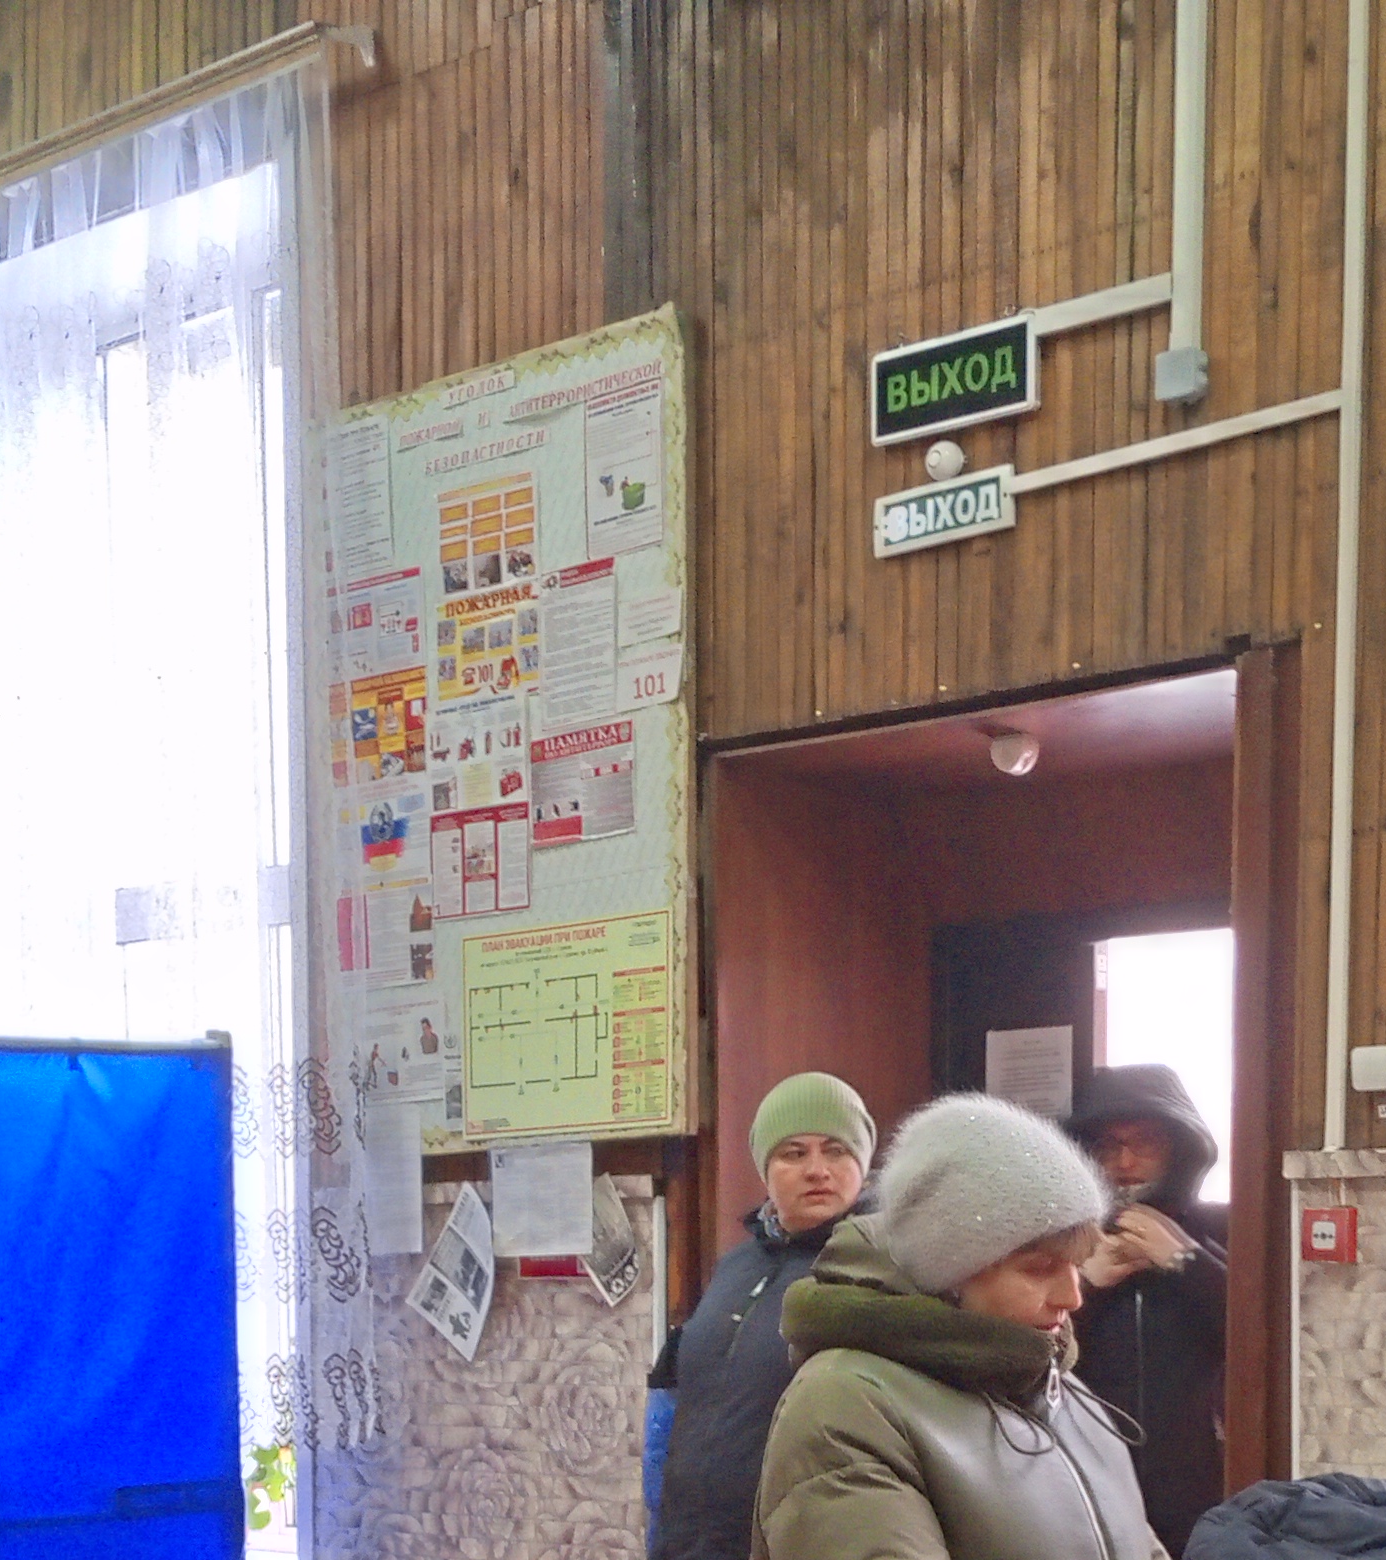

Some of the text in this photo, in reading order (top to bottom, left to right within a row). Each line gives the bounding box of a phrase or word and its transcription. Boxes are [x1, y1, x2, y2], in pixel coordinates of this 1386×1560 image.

[448, 375, 506, 405] УГОЛОК
[886, 345, 1017, 414] ВЫХОД
[884, 483, 1002, 543] ВЫХОД
[633, 671, 666, 700] 101
